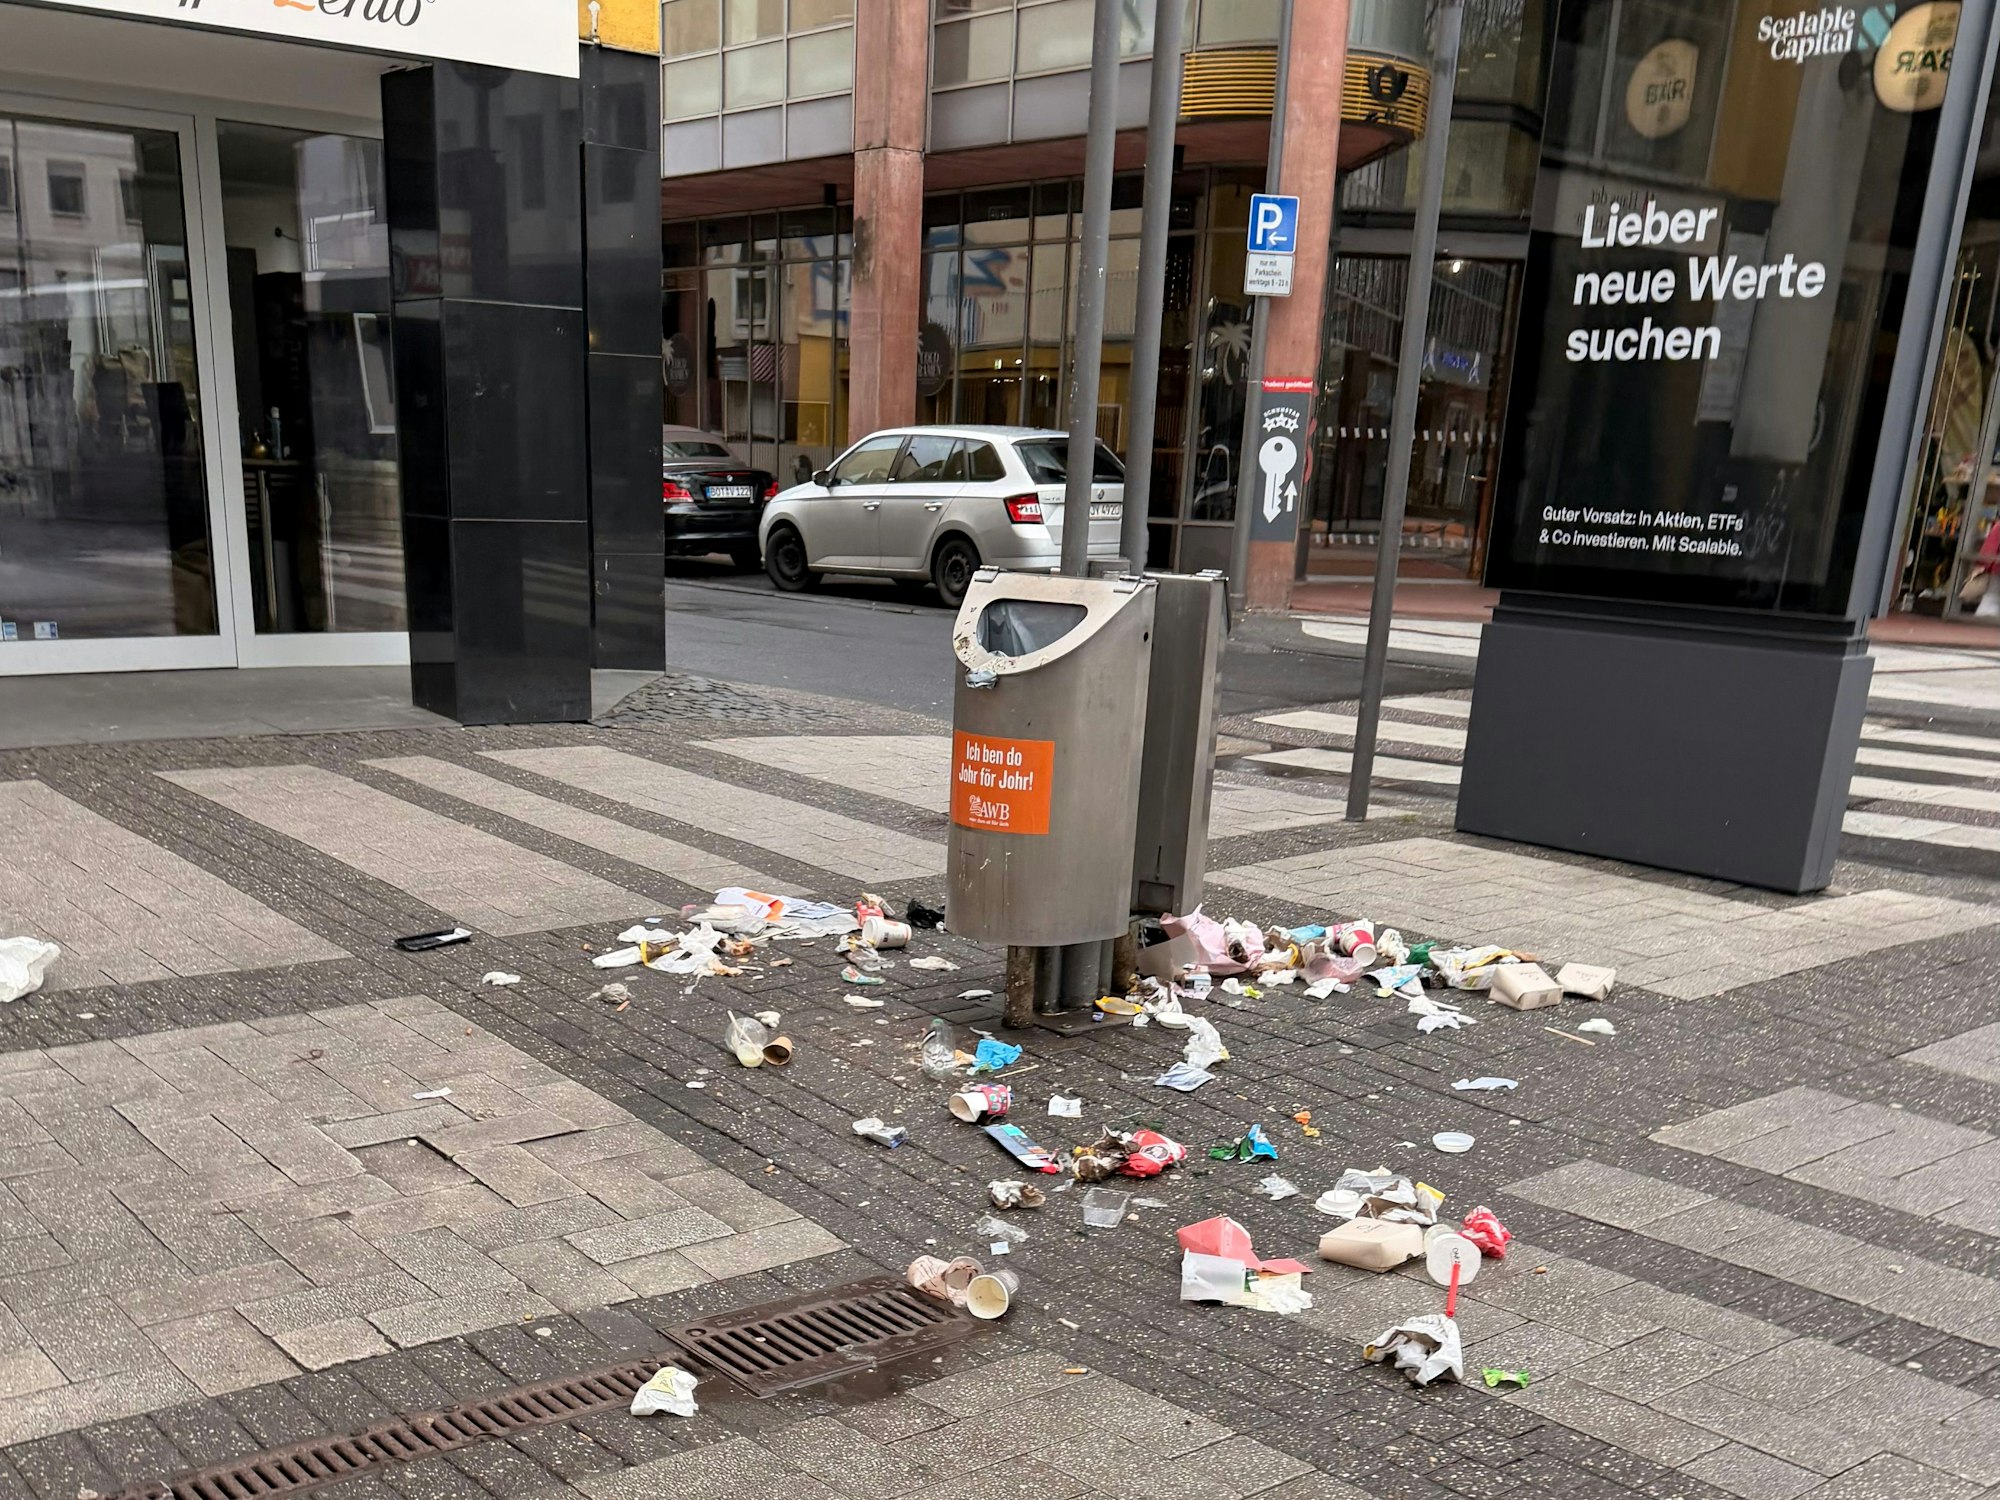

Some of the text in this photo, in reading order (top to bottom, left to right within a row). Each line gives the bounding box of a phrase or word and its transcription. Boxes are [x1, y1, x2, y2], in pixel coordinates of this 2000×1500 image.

[1758, 6, 1856, 42] Scalable
[1770, 30, 1854, 64] Capital
[1256, 202, 1282, 244] P
[1581, 200, 1718, 248] Lieber
[1573, 254, 1826, 305] neue Werte
[1566, 316, 1721, 362] suchen
[1542, 506, 1744, 532] Guter Vorsatz: In Aktien, ETFs
[1539, 528, 1743, 556] & Co investieren. Mit Scalable.
[966, 740, 1022, 766] Ich ben do
[959, 762, 1034, 791] Johr för Johr!
[980, 802, 1010, 820] AWB
